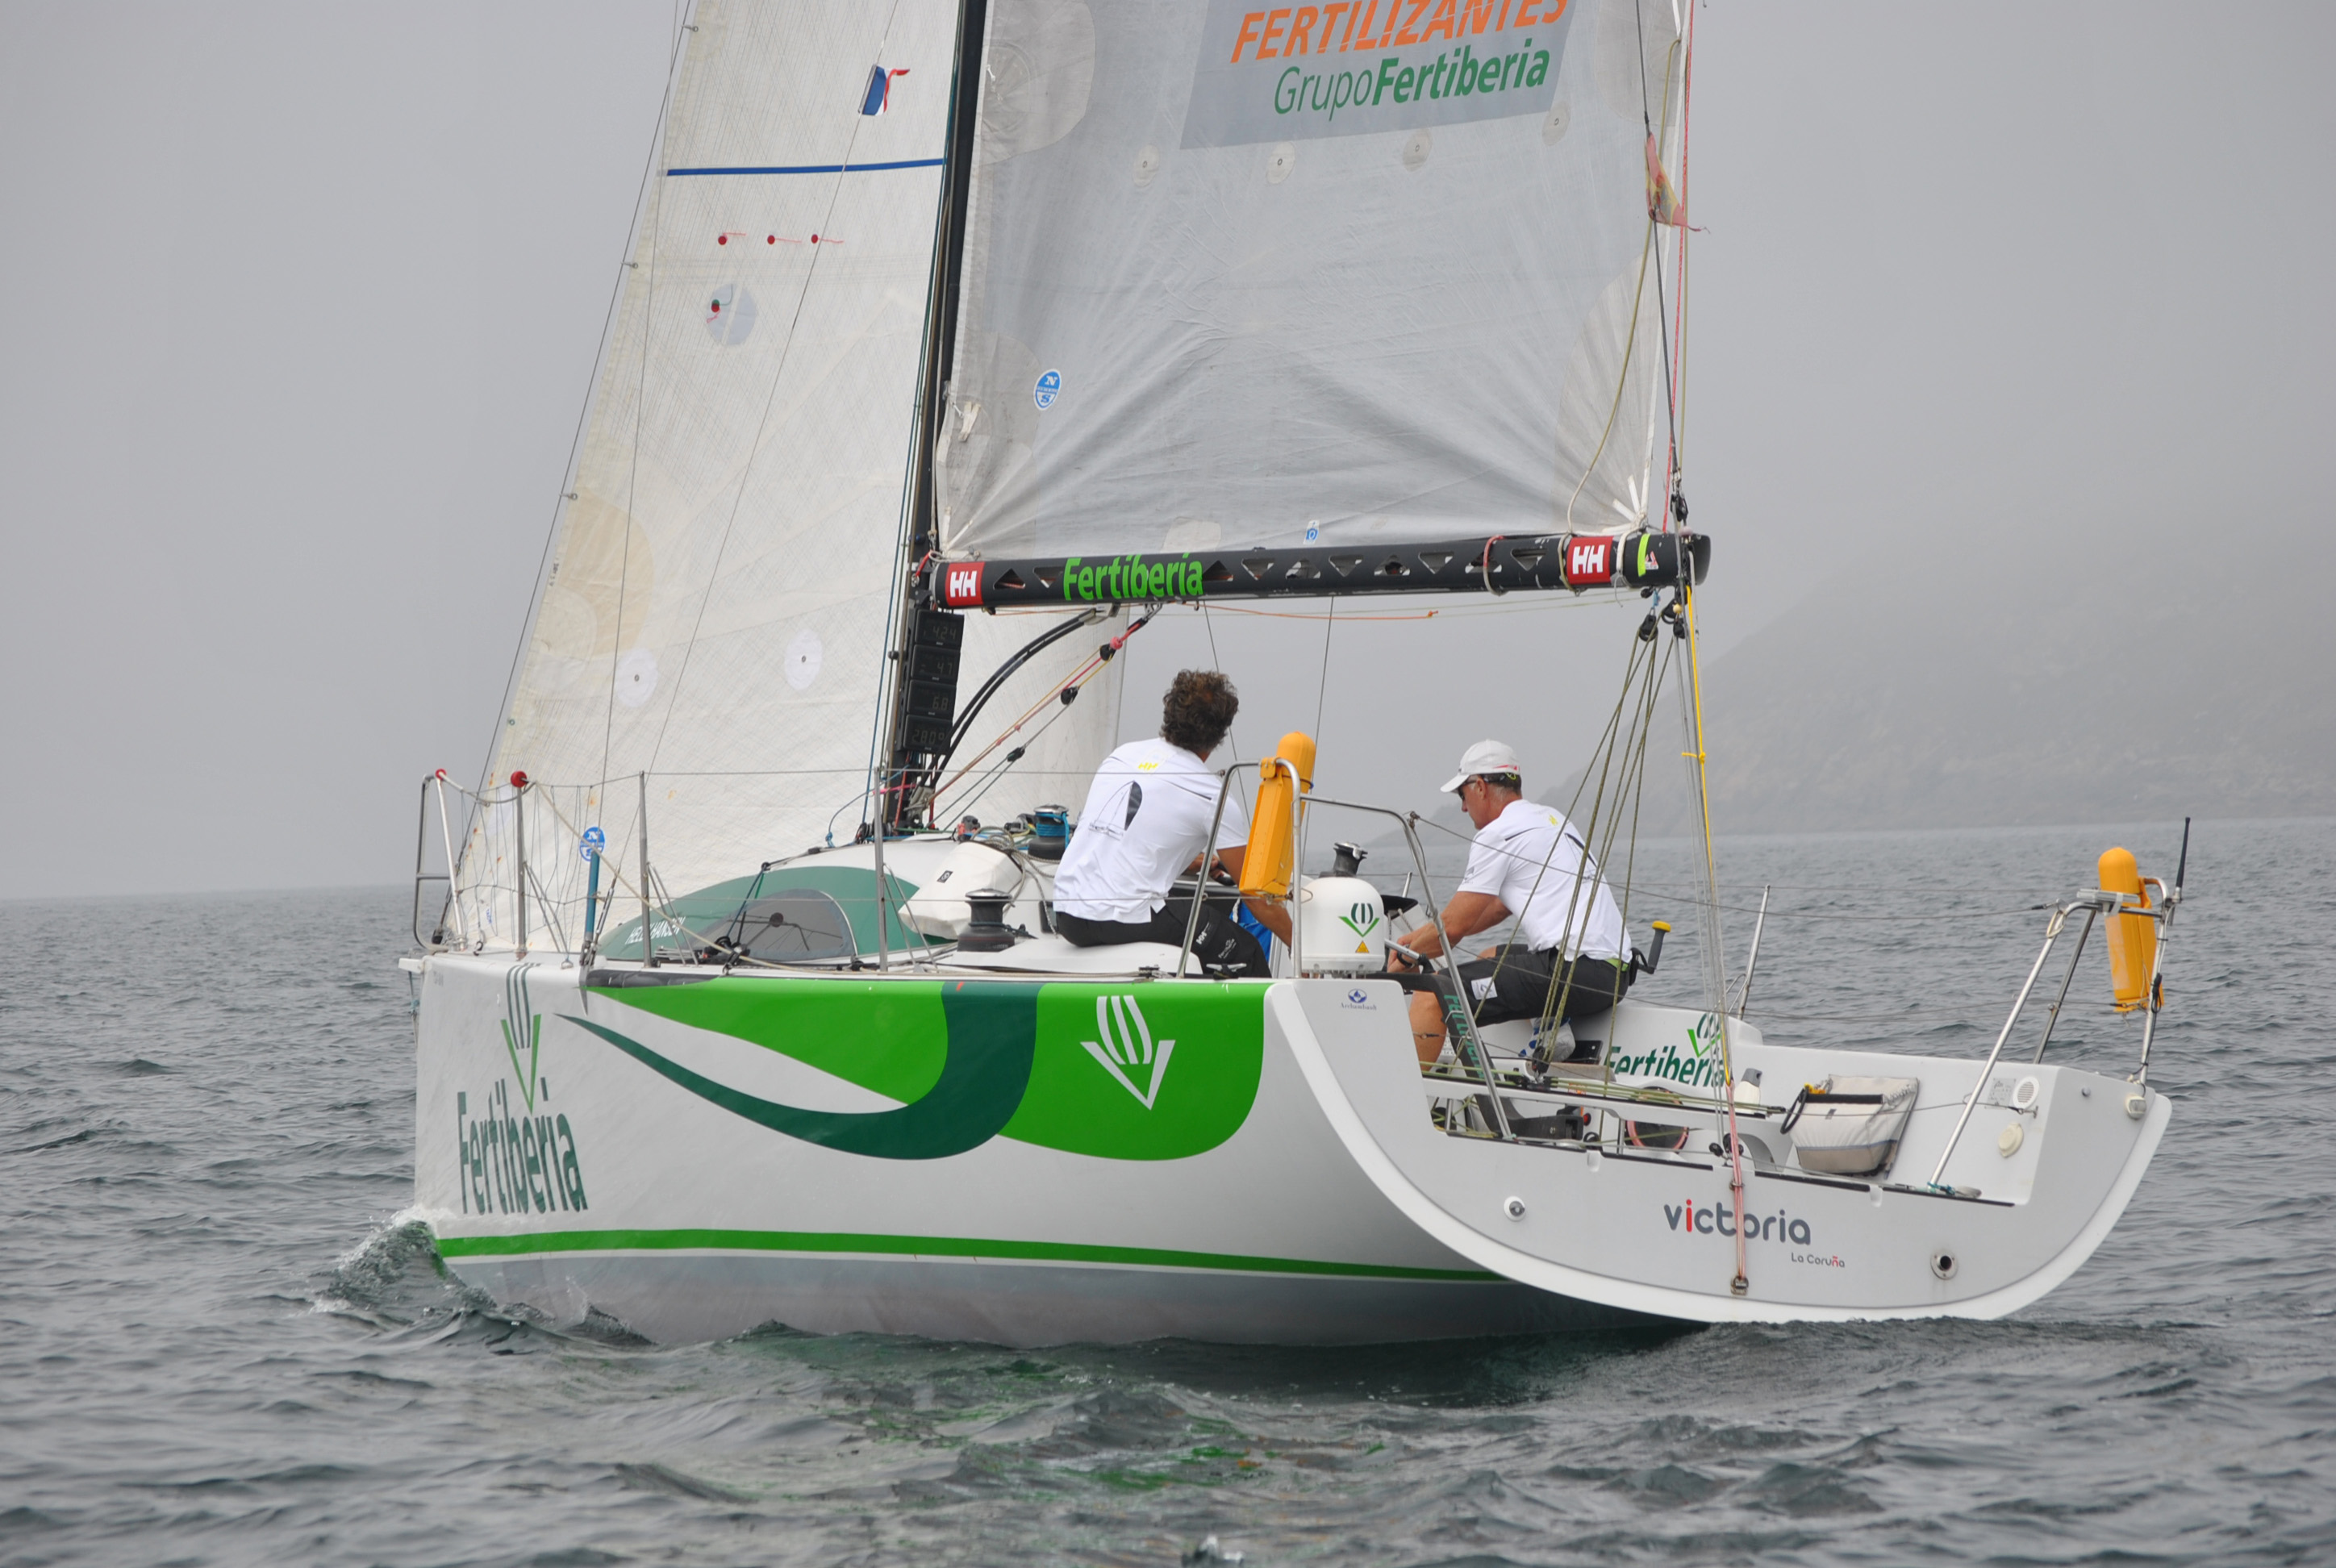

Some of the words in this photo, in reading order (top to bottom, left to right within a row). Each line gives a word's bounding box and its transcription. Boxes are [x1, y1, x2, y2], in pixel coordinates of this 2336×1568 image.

[1062, 552, 1203, 601] Fertiberia
[1571, 544, 1605, 574] HH
[949, 570, 977, 598] HH
[1604, 1045, 1725, 1087] Fertiberia
[457, 1077, 589, 1216] Fertiberia
[1664, 1199, 1811, 1245] victoria
[1792, 1252, 1804, 1263] La
[1807, 1254, 1846, 1268] Coruña
